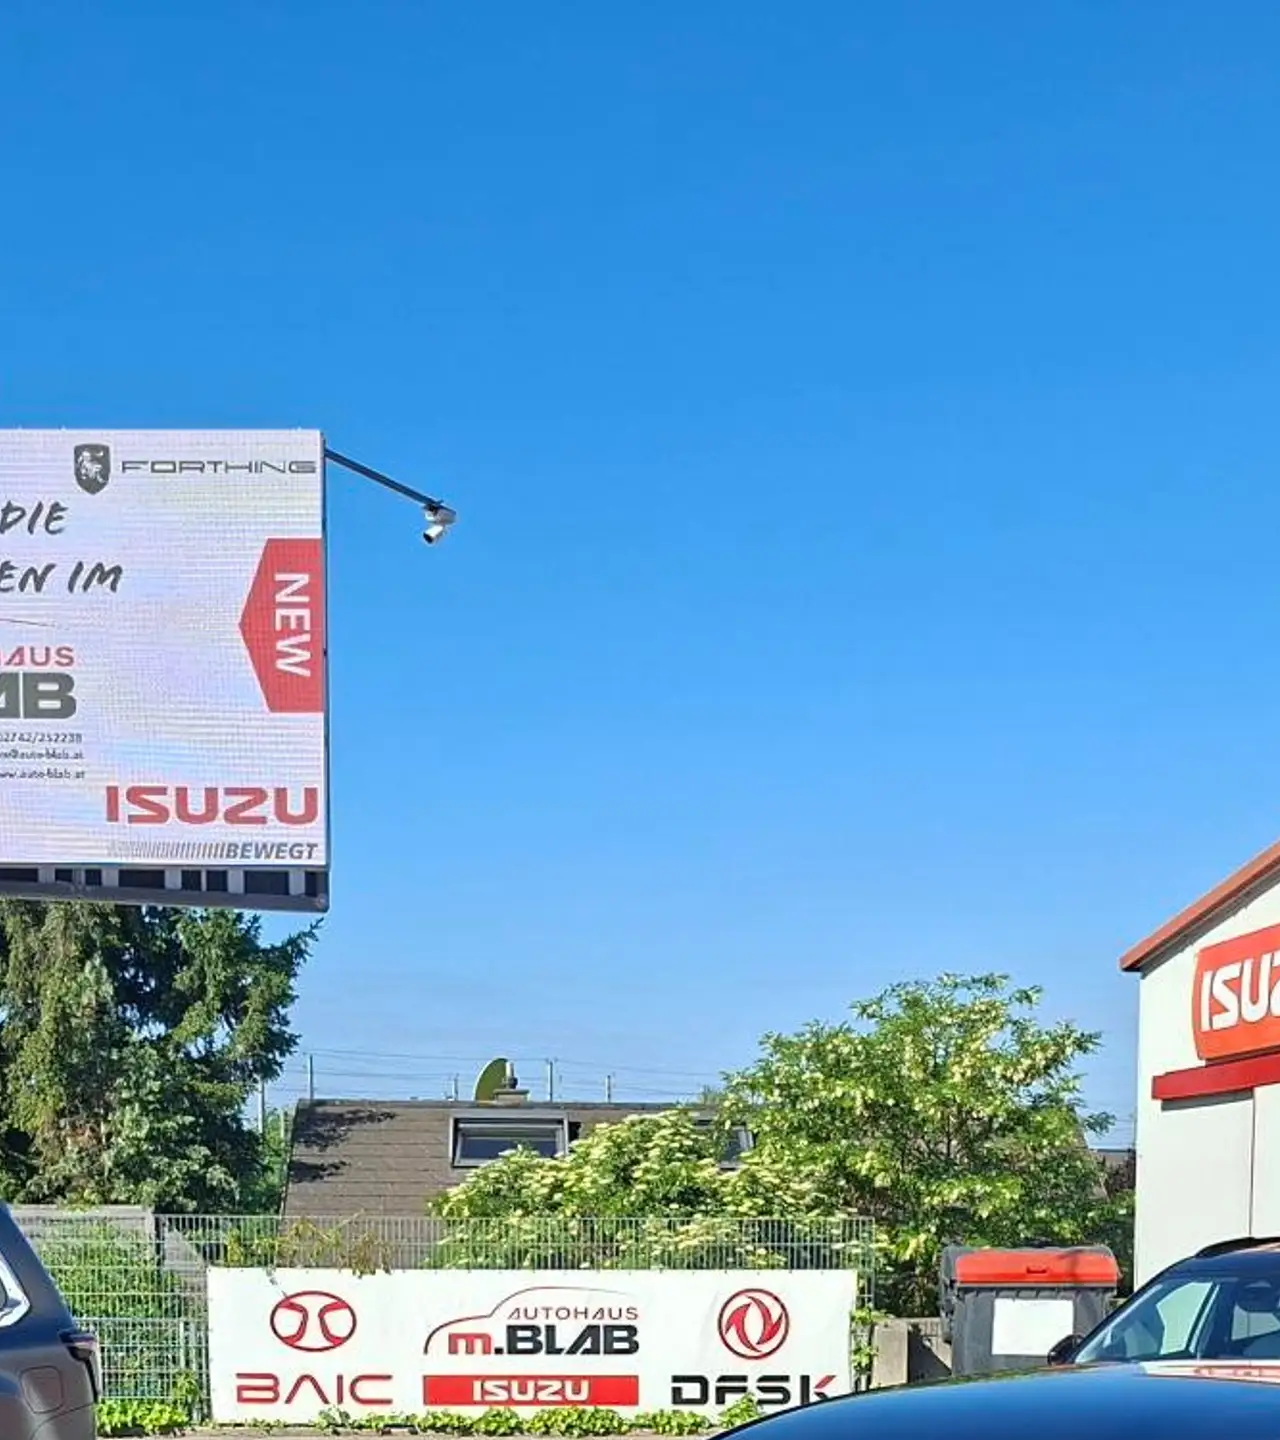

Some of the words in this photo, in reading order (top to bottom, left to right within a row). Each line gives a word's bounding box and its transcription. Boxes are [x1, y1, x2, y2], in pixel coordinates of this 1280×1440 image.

[122, 460, 317, 475] FORTHING
[0, 502, 68, 536] DIE
[68, 563, 124, 596] IM
[274, 573, 312, 679] NEW
[105, 786, 318, 826] ISUZU
[226, 842, 318, 860] BEWEGT
[508, 1307, 638, 1319] AUTOHAUS
[447, 1325, 639, 1355] m.BLAB
[236, 1373, 393, 1405] BAIC
[472, 1379, 589, 1400] ISUZU
[671, 1374, 837, 1405] DFSK
